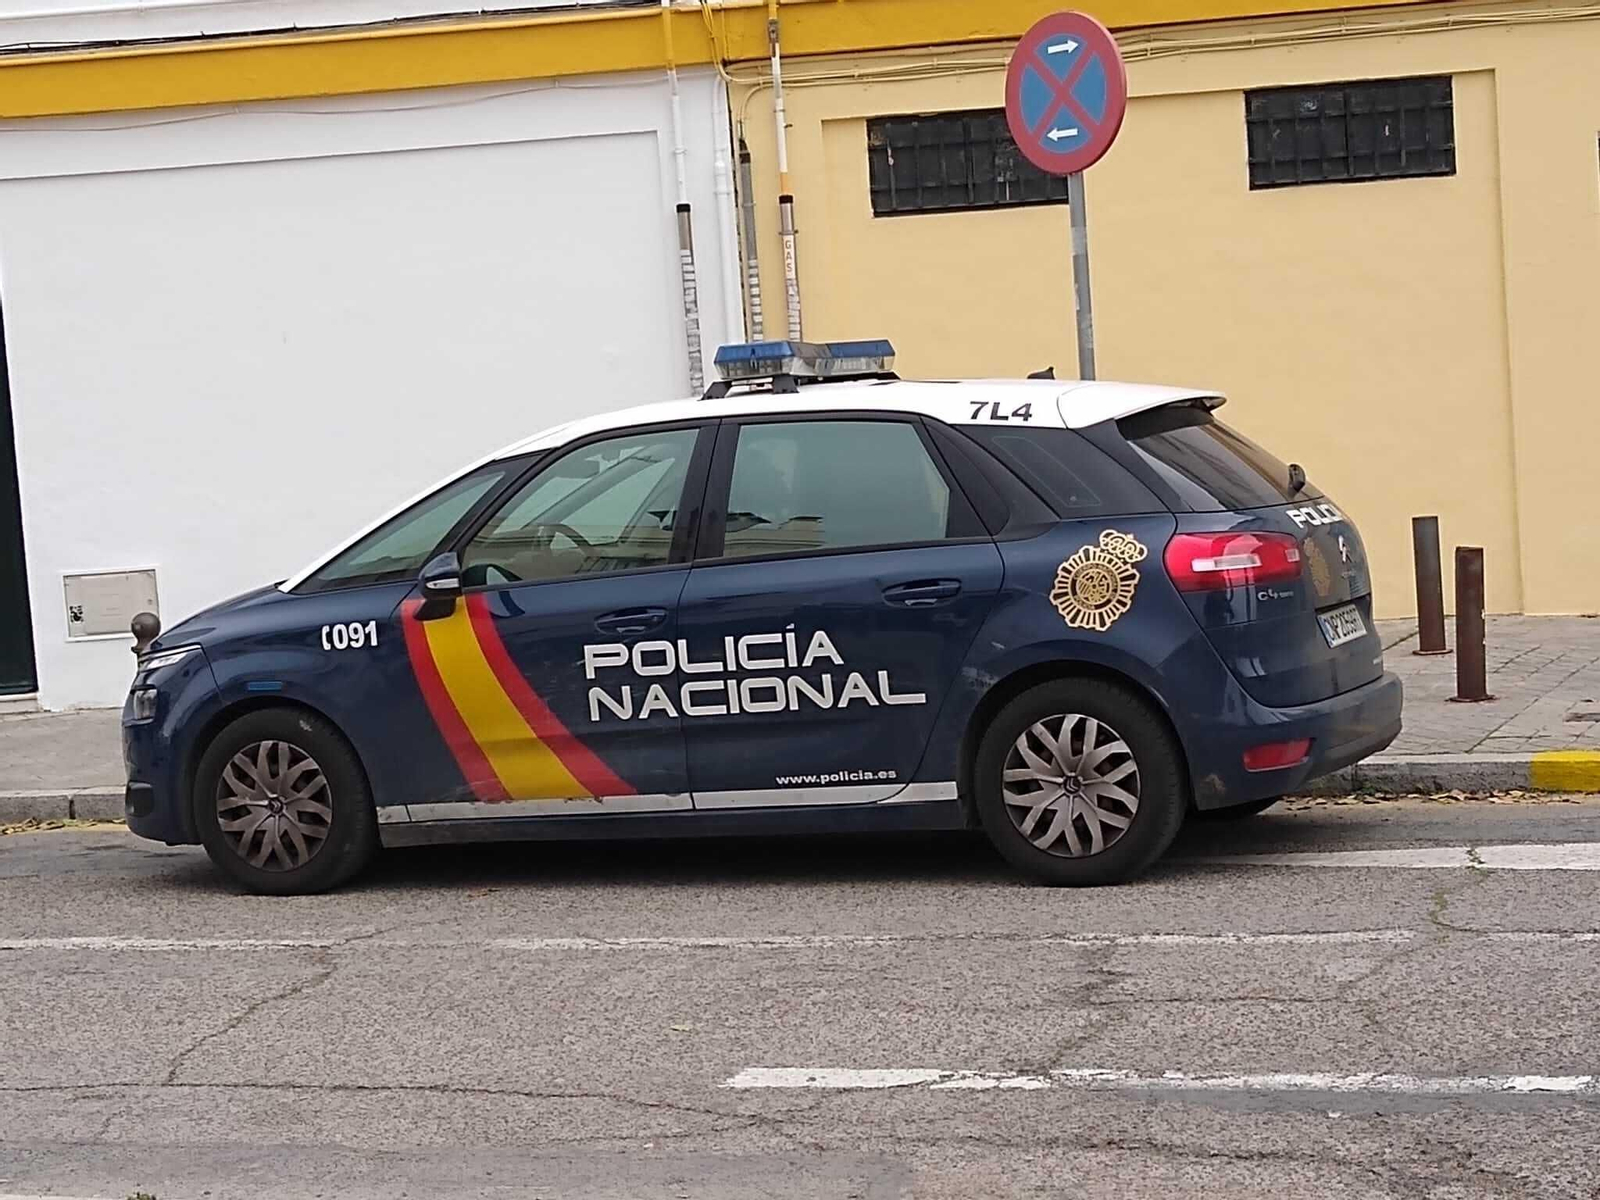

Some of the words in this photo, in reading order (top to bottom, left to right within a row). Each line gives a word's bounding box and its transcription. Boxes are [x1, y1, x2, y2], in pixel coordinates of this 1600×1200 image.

[785, 240, 793, 272] GAS
[969, 400, 1033, 421] 7L4
[332, 620, 378, 650] 091
[583, 623, 844, 680] POLICÍA
[588, 669, 926, 721] NACIONAL
[775, 769, 897, 786] www.policia.es
